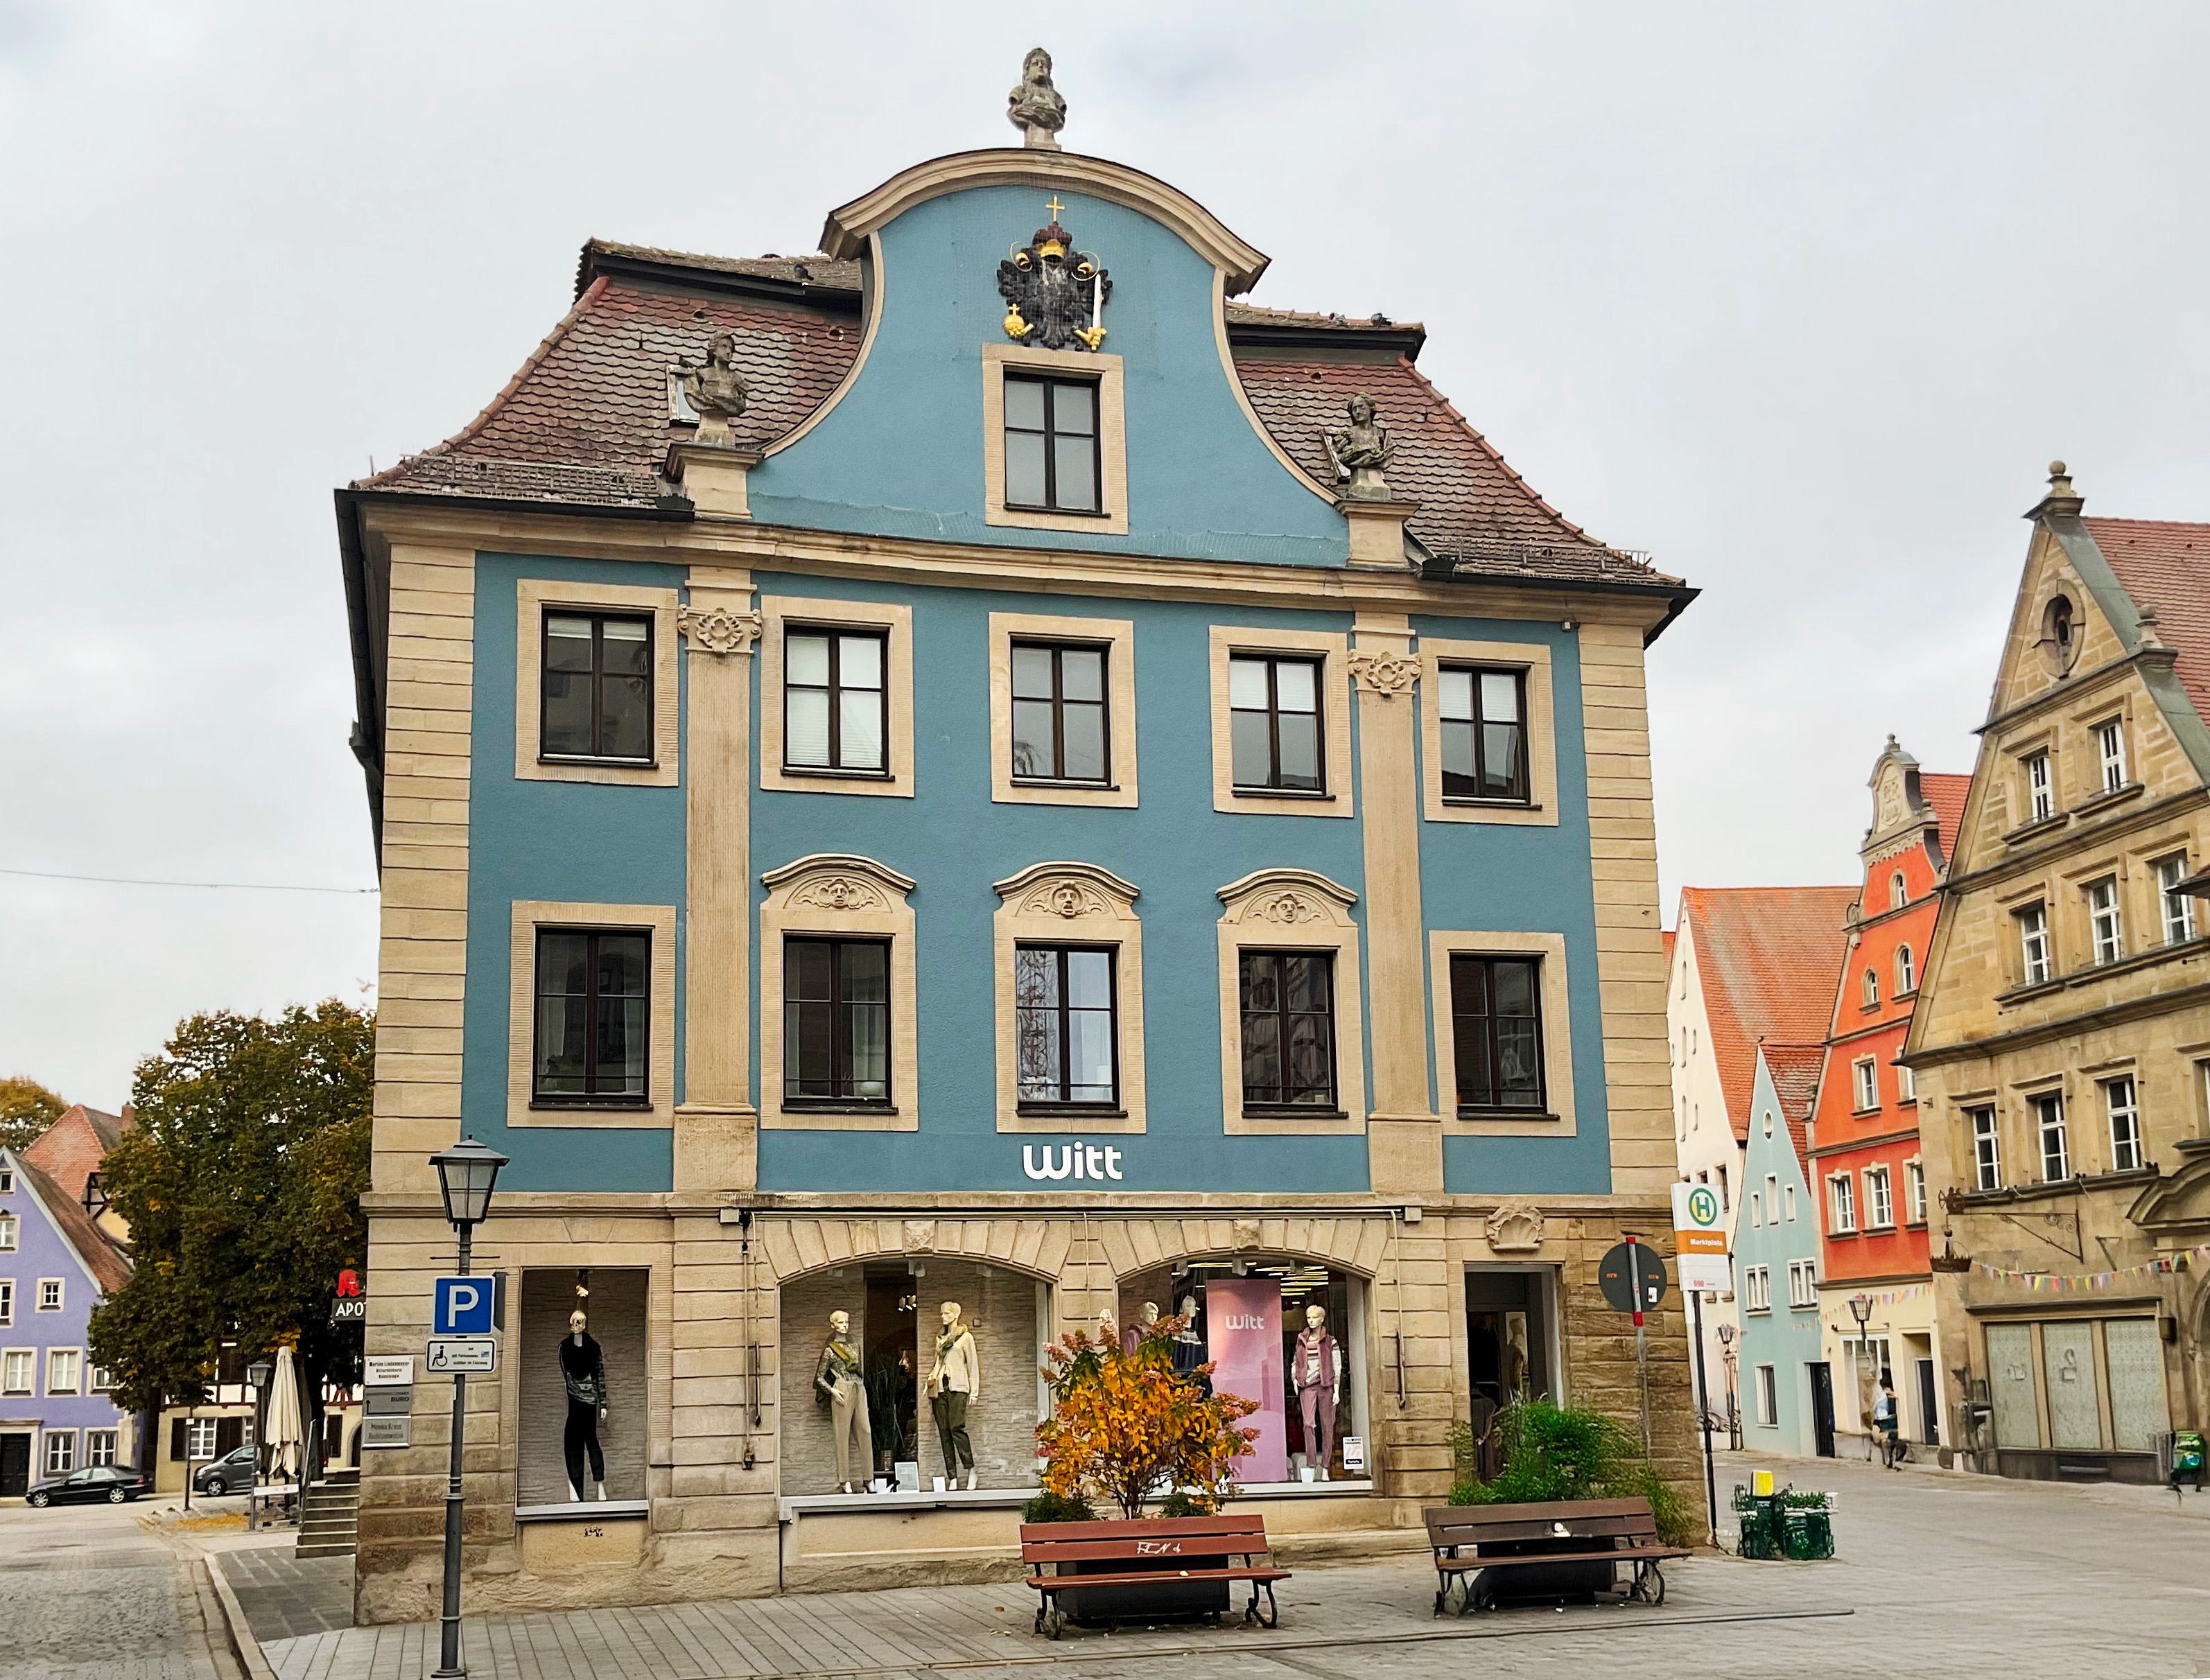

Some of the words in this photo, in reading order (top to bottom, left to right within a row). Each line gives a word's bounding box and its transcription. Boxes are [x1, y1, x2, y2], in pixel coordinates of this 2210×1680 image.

[1023, 1141, 1123, 1180] Witt
[1696, 1196, 1710, 1218] H
[336, 1301, 367, 1317] APO
[448, 1285, 479, 1327] P
[1225, 1314, 1264, 1330] Witt
